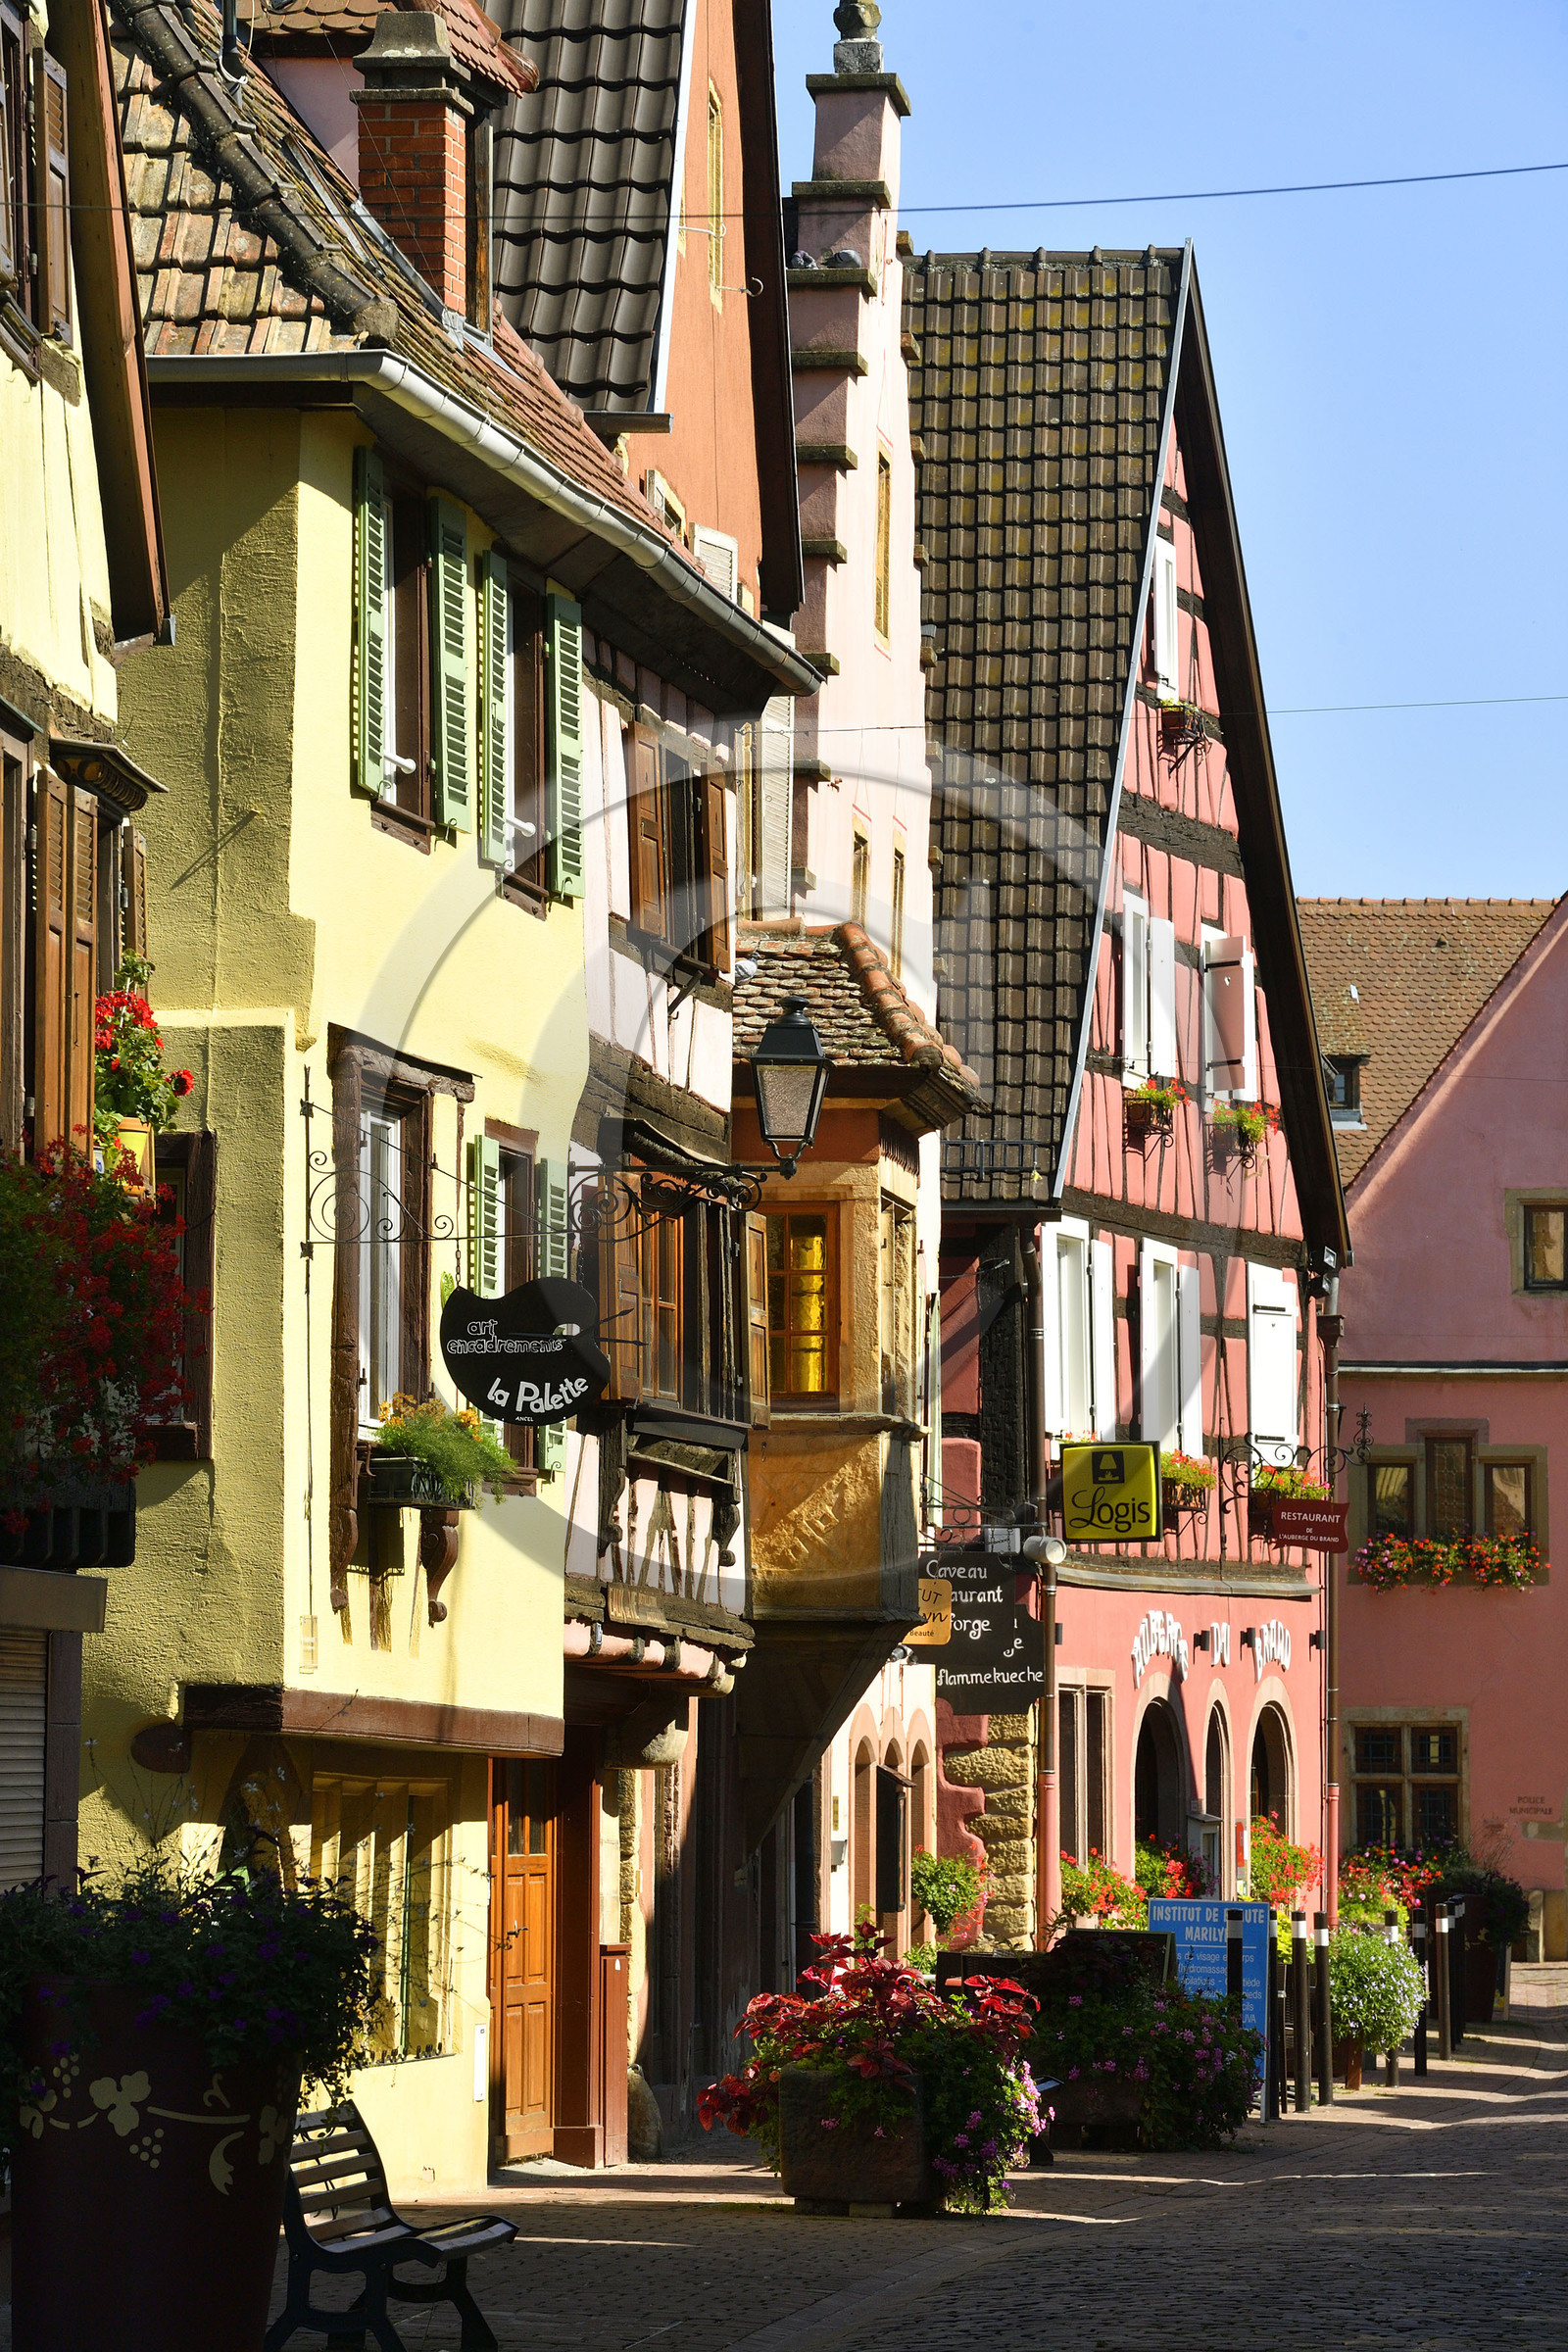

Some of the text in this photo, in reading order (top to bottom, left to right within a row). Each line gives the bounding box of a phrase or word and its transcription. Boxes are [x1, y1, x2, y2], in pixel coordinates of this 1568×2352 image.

[466, 1319, 498, 1336] art
[447, 1336, 563, 1354] encadrements
[487, 1377, 589, 1413] la Palette
[1069, 1486, 1151, 1533] Logis
[1281, 1511, 1341, 1524] RESTAURANT
[926, 1559, 988, 1579] Caveau
[1131, 1610, 1189, 1690] AUBERGE
[937, 1666, 1045, 1687] flammekueche
[1517, 1795, 1545, 1804] POLICE
[1152, 1905, 1201, 1923] INSTITUT
[1205, 1907, 1219, 1923] DE
[1196, 1951, 1220, 1964] visage
